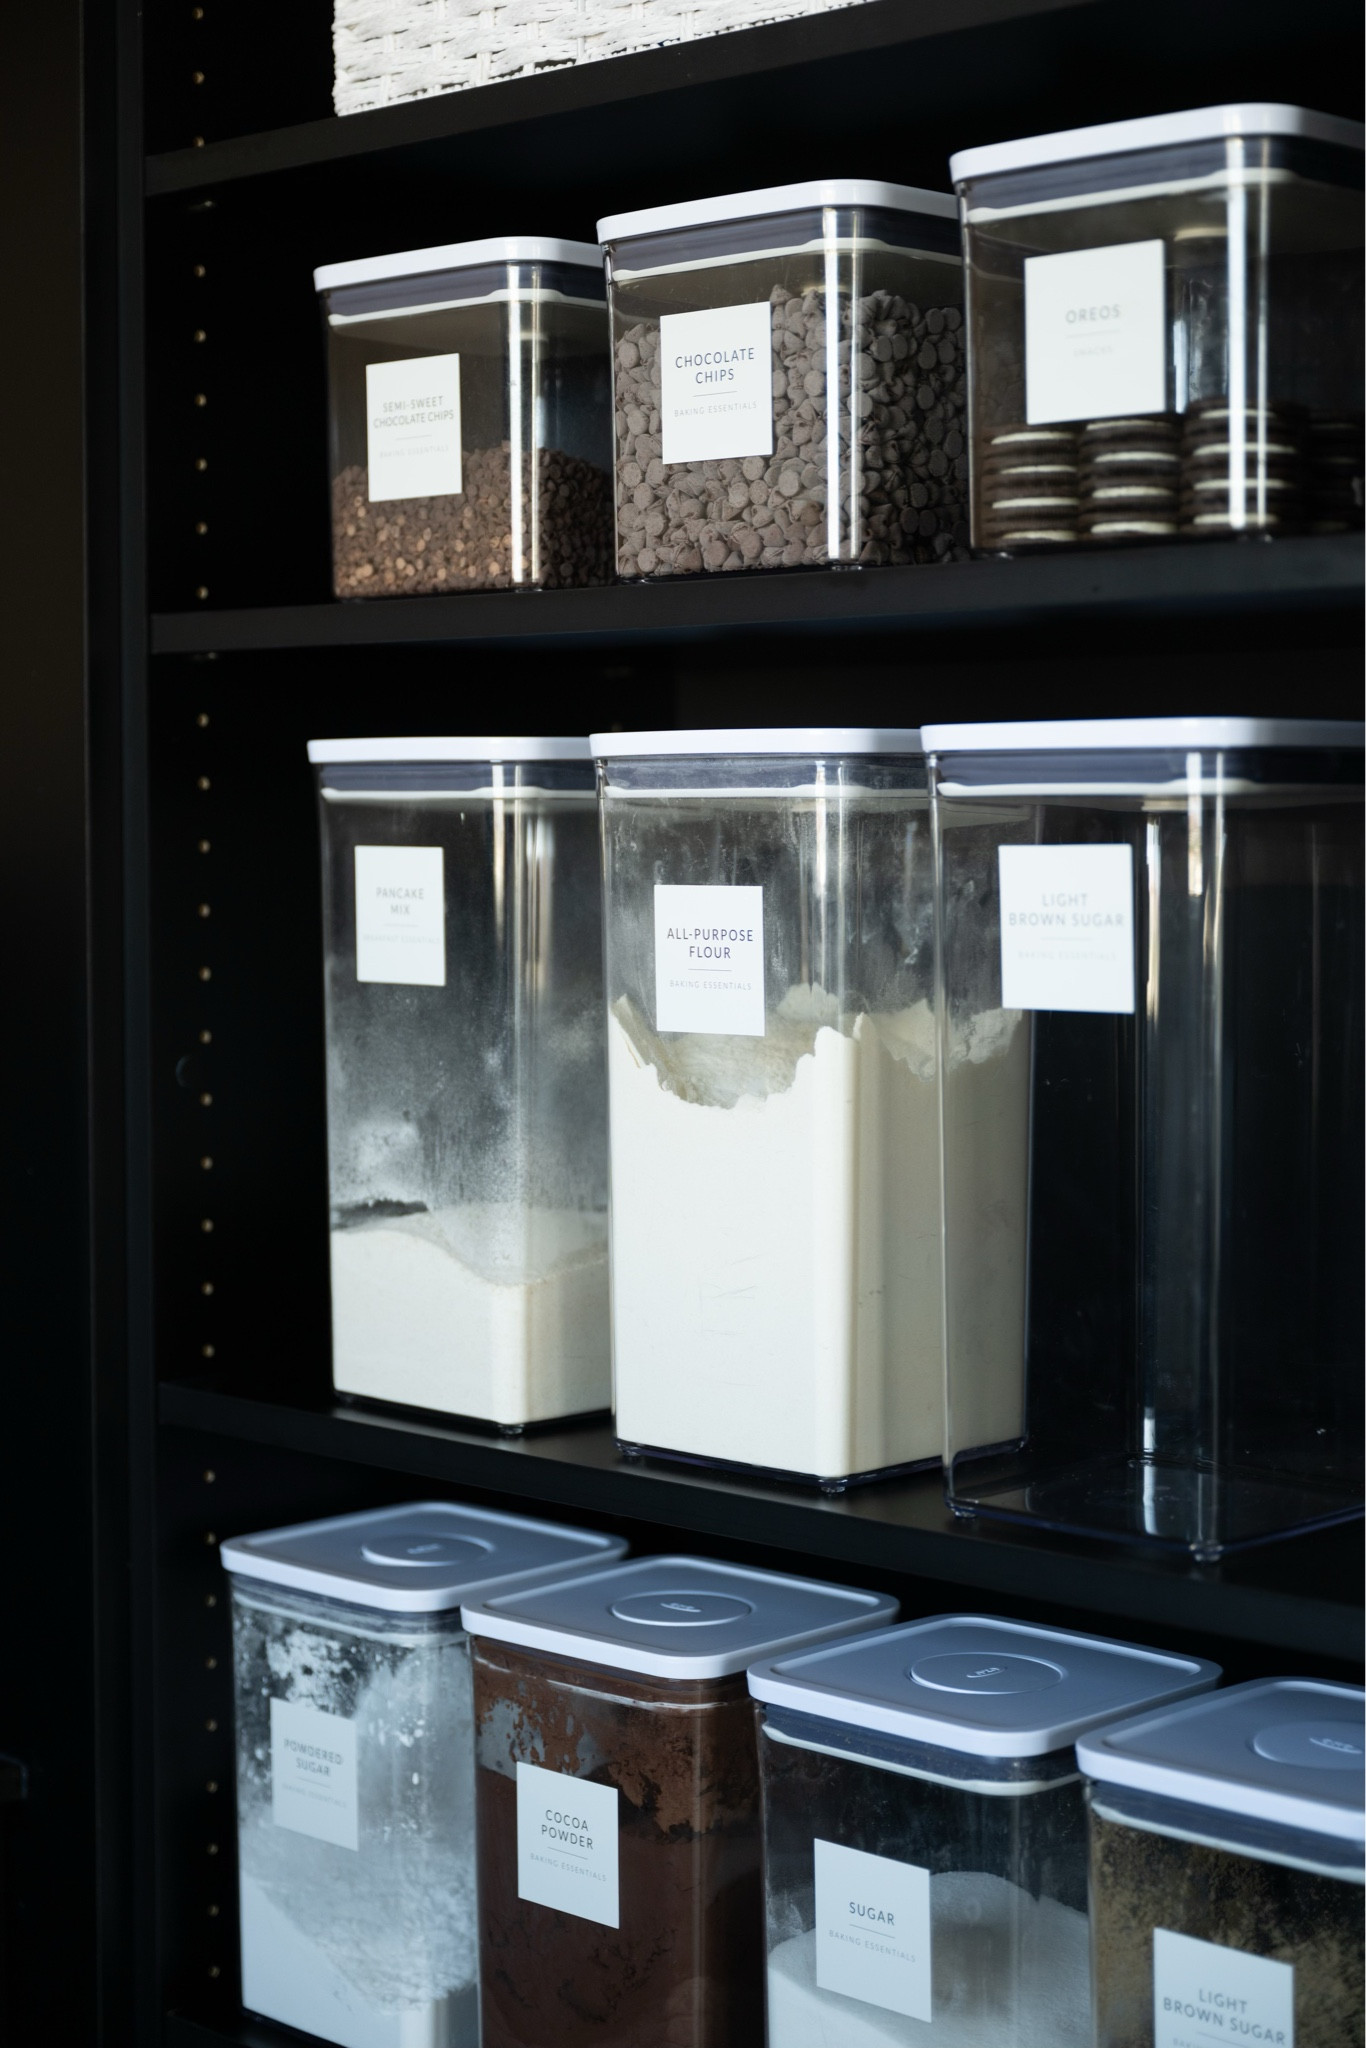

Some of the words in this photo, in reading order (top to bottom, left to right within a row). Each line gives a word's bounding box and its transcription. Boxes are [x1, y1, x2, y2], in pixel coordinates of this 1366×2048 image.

[1064, 303, 1121, 324] OREOS
[675, 347, 755, 369] CHOCOLATE
[695, 368, 735, 385] CHIPS
[382, 395, 443, 413] SEMI-SWEET
[673, 406, 705, 418] BAKING
[708, 400, 758, 414] ESSENTIALS
[374, 412, 426, 429] CHOCOLATE
[427, 408, 454, 422] CHIPS
[375, 886, 425, 900] PANCAKE
[1041, 893, 1088, 907] LIGHT
[389, 903, 411, 916] MIX
[1008, 912, 1067, 927] BROWN
[1071, 912, 1125, 928] SUGAR
[666, 927, 755, 942] ALL-PURPOSE
[688, 945, 732, 959] FLOUR
[669, 979, 699, 990] BAKING
[702, 980, 752, 991] ESSENTIALS
[283, 1738, 345, 1766] POWDERED
[295, 1756, 332, 1777] SUGAR
[545, 1809, 589, 1832] COCOA
[541, 1823, 594, 1850] POWDER
[529, 1852, 559, 1868] BAKING
[560, 1861, 608, 1882] ESSENTIALS
[848, 1901, 895, 1926] SUGAR
[828, 1929, 861, 1946] BAKING
[864, 1939, 916, 1963] ESSENTIALS
[1198, 1988, 1248, 2015] LIGHT
[1163, 1996, 1223, 2028] BROWN
[1229, 2016, 1286, 2046] SUGAR
